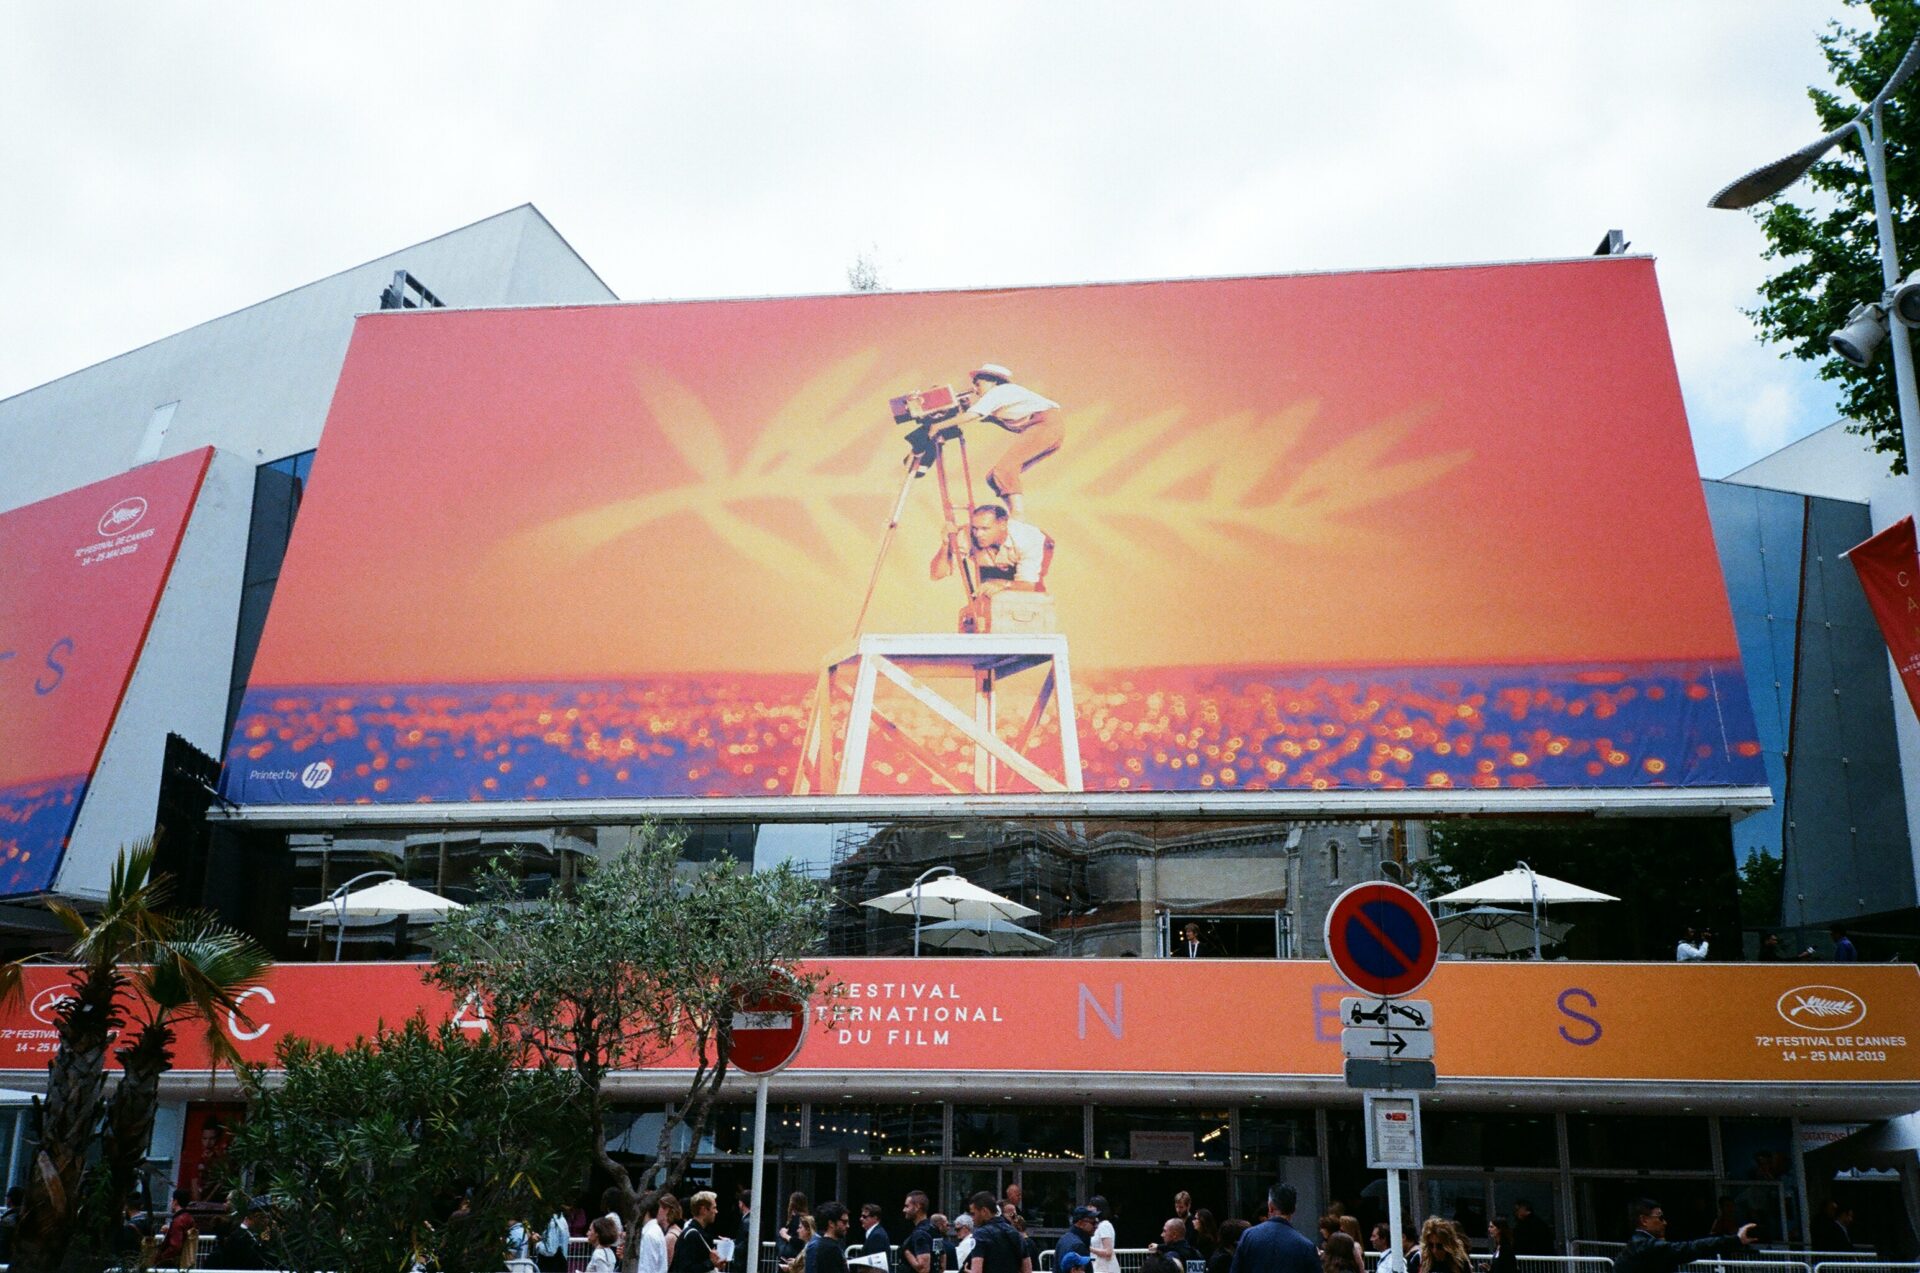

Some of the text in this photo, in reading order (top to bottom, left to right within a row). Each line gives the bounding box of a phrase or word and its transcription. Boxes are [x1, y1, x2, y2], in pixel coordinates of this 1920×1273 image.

[249, 769, 298, 781] Printed by
[303, 761, 331, 789] hp
[816, 1006, 1003, 1022] TERNATIONAL
[838, 1029, 949, 1045] DU FILM
[1776, 1036, 1834, 1047] FESTIVAL
[1837, 1036, 1853, 1047] DE
[1856, 1036, 1906, 1047] CANNES
[16, 1043, 28, 1052] 14
[36, 1043, 50, 1052] 25
[1782, 1051, 1797, 1062] 14
[1811, 1051, 1826, 1062] 25
[1829, 1051, 1854, 1062] MAI
[1856, 1051, 1886, 1062] 2019
